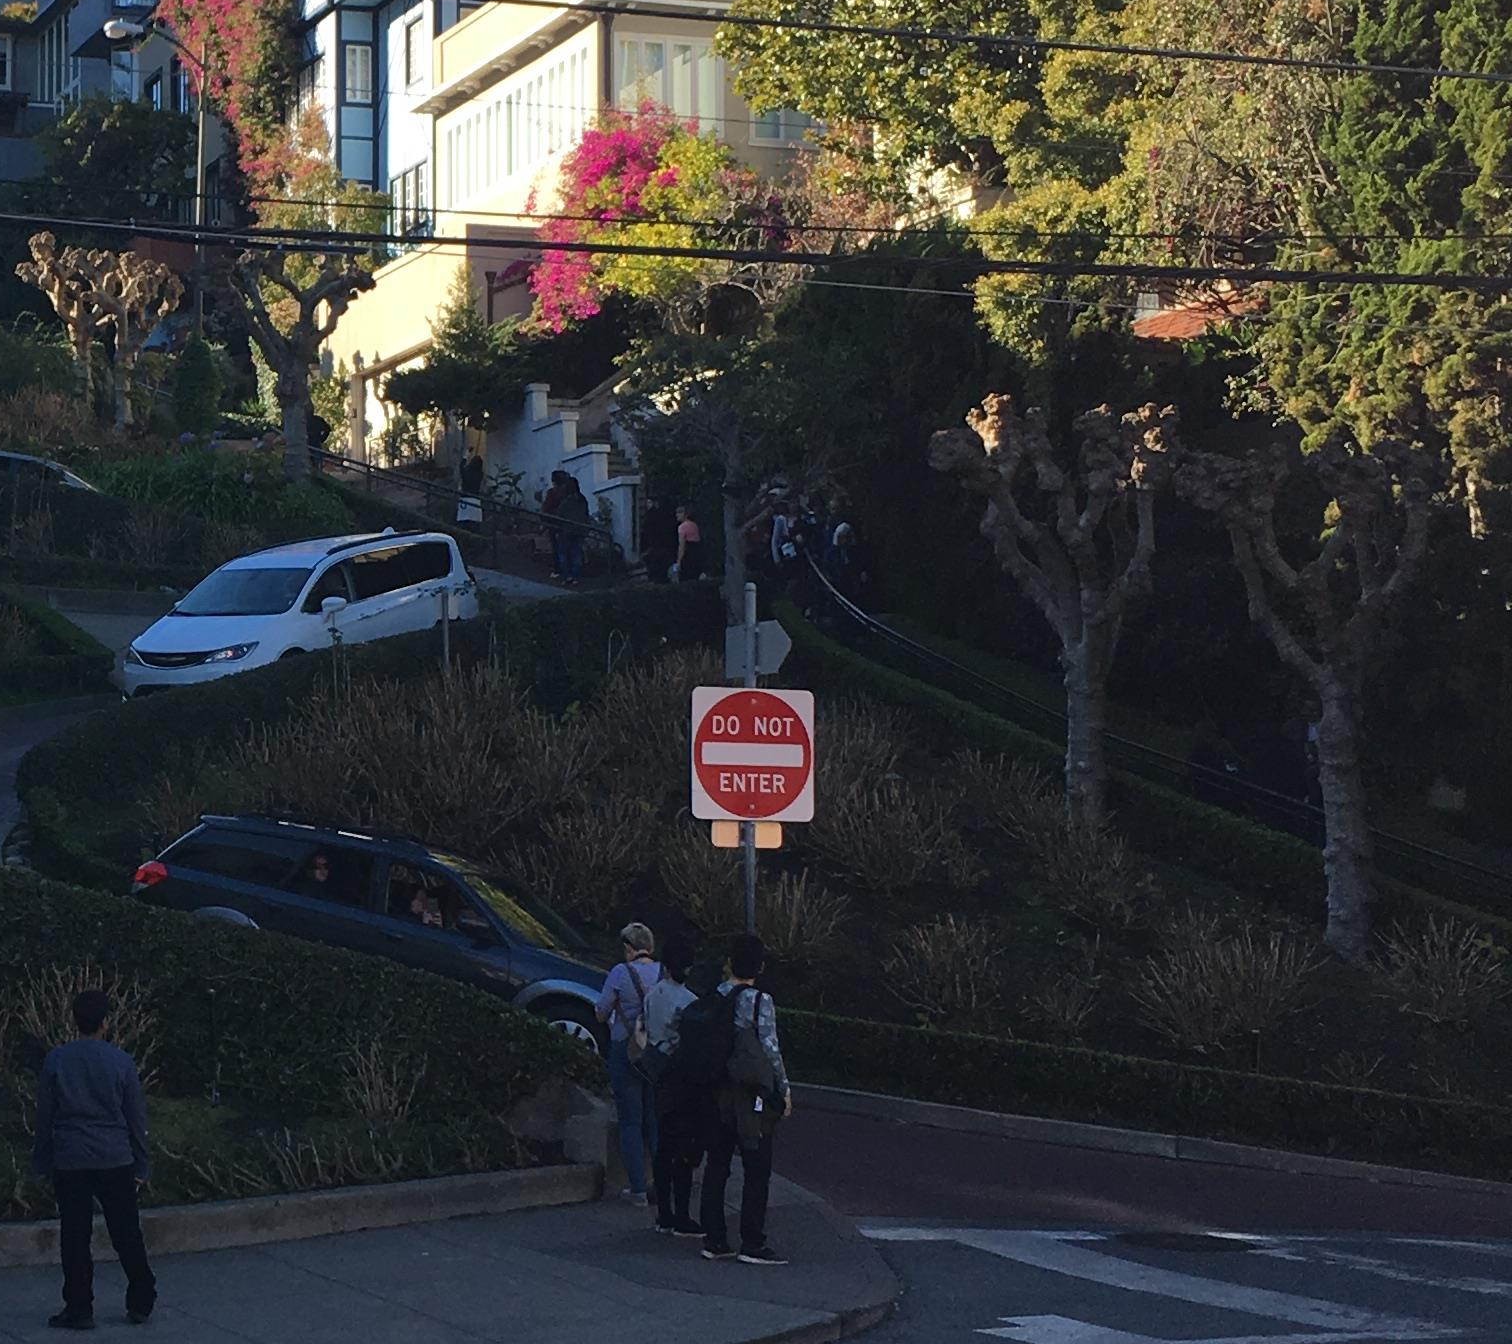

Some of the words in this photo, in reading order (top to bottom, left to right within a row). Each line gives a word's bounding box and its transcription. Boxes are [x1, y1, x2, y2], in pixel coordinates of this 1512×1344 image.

[712, 715, 740, 735] DO
[754, 716, 794, 736] NOT
[719, 772, 786, 793] ENTER
